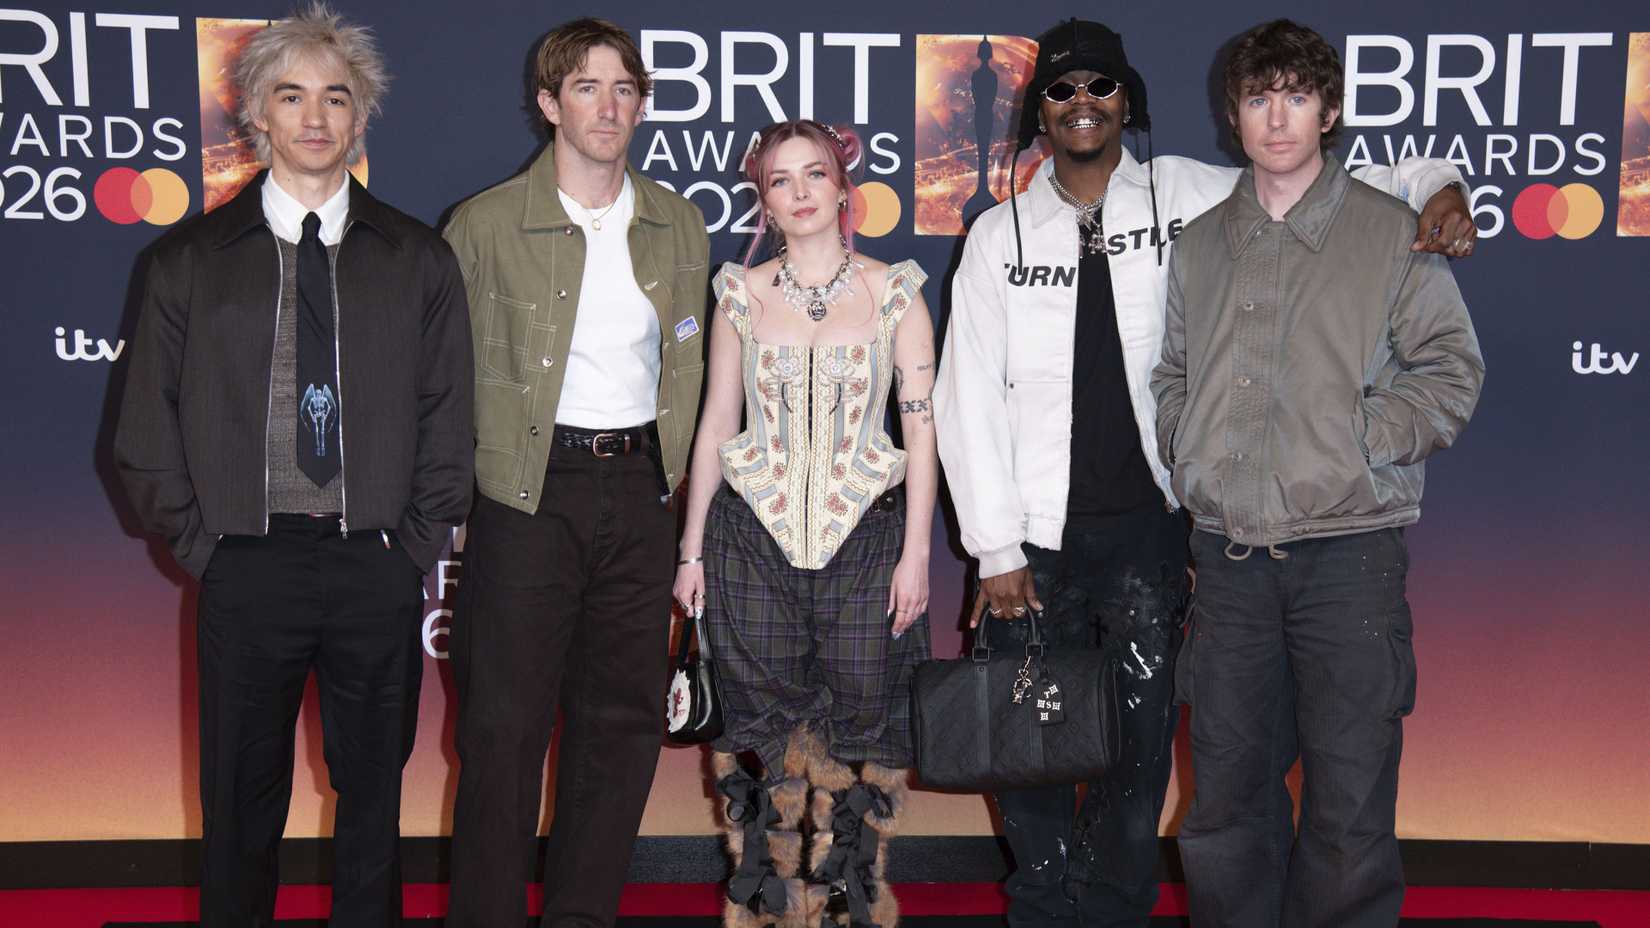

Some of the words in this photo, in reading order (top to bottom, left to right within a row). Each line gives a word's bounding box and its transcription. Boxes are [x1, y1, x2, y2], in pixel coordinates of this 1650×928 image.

[0, 9, 180, 109] RIT
[641, 30, 900, 124] BRIT
[1343, 33, 1613, 127] BRIT
[0, 114, 187, 161] ARDS
[1344, 133, 1606, 176] AWARDS
[0, 166, 87, 222] 26
[55, 327, 125, 361] itv
[1572, 341, 1639, 375] itv
